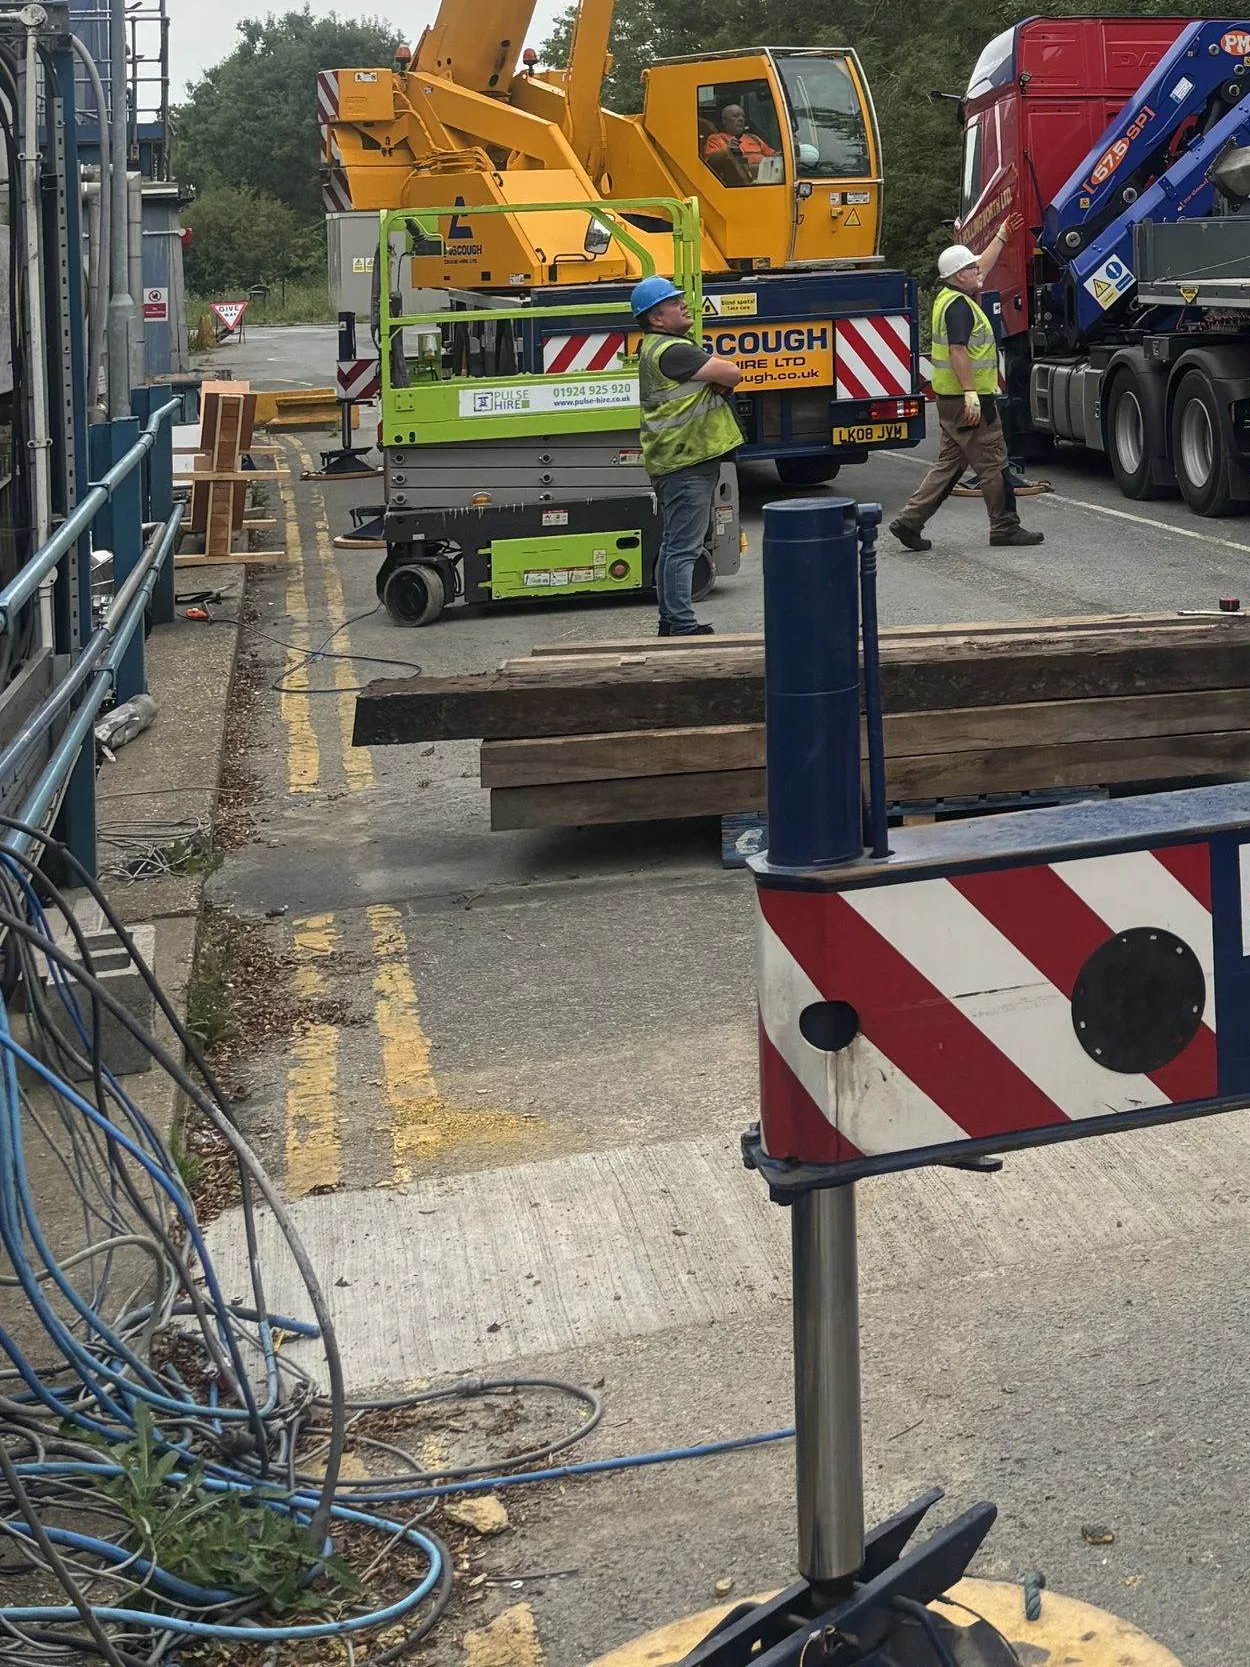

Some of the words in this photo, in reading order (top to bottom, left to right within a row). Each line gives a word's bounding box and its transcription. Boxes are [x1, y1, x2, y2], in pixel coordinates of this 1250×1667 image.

[1224, 34, 1250, 54] PM
[1111, 51, 1161, 67] DA
[775, 356, 806, 368] LTD
[494, 389, 529, 401] PULSE
[553, 386, 586, 398] 01924
[588, 385, 608, 396] 925
[611, 383, 631, 394] 920
[494, 399, 521, 411] HIRE
[553, 394, 631, 407] www.pulse-hire.co.uk
[839, 427, 873, 442] LK08
